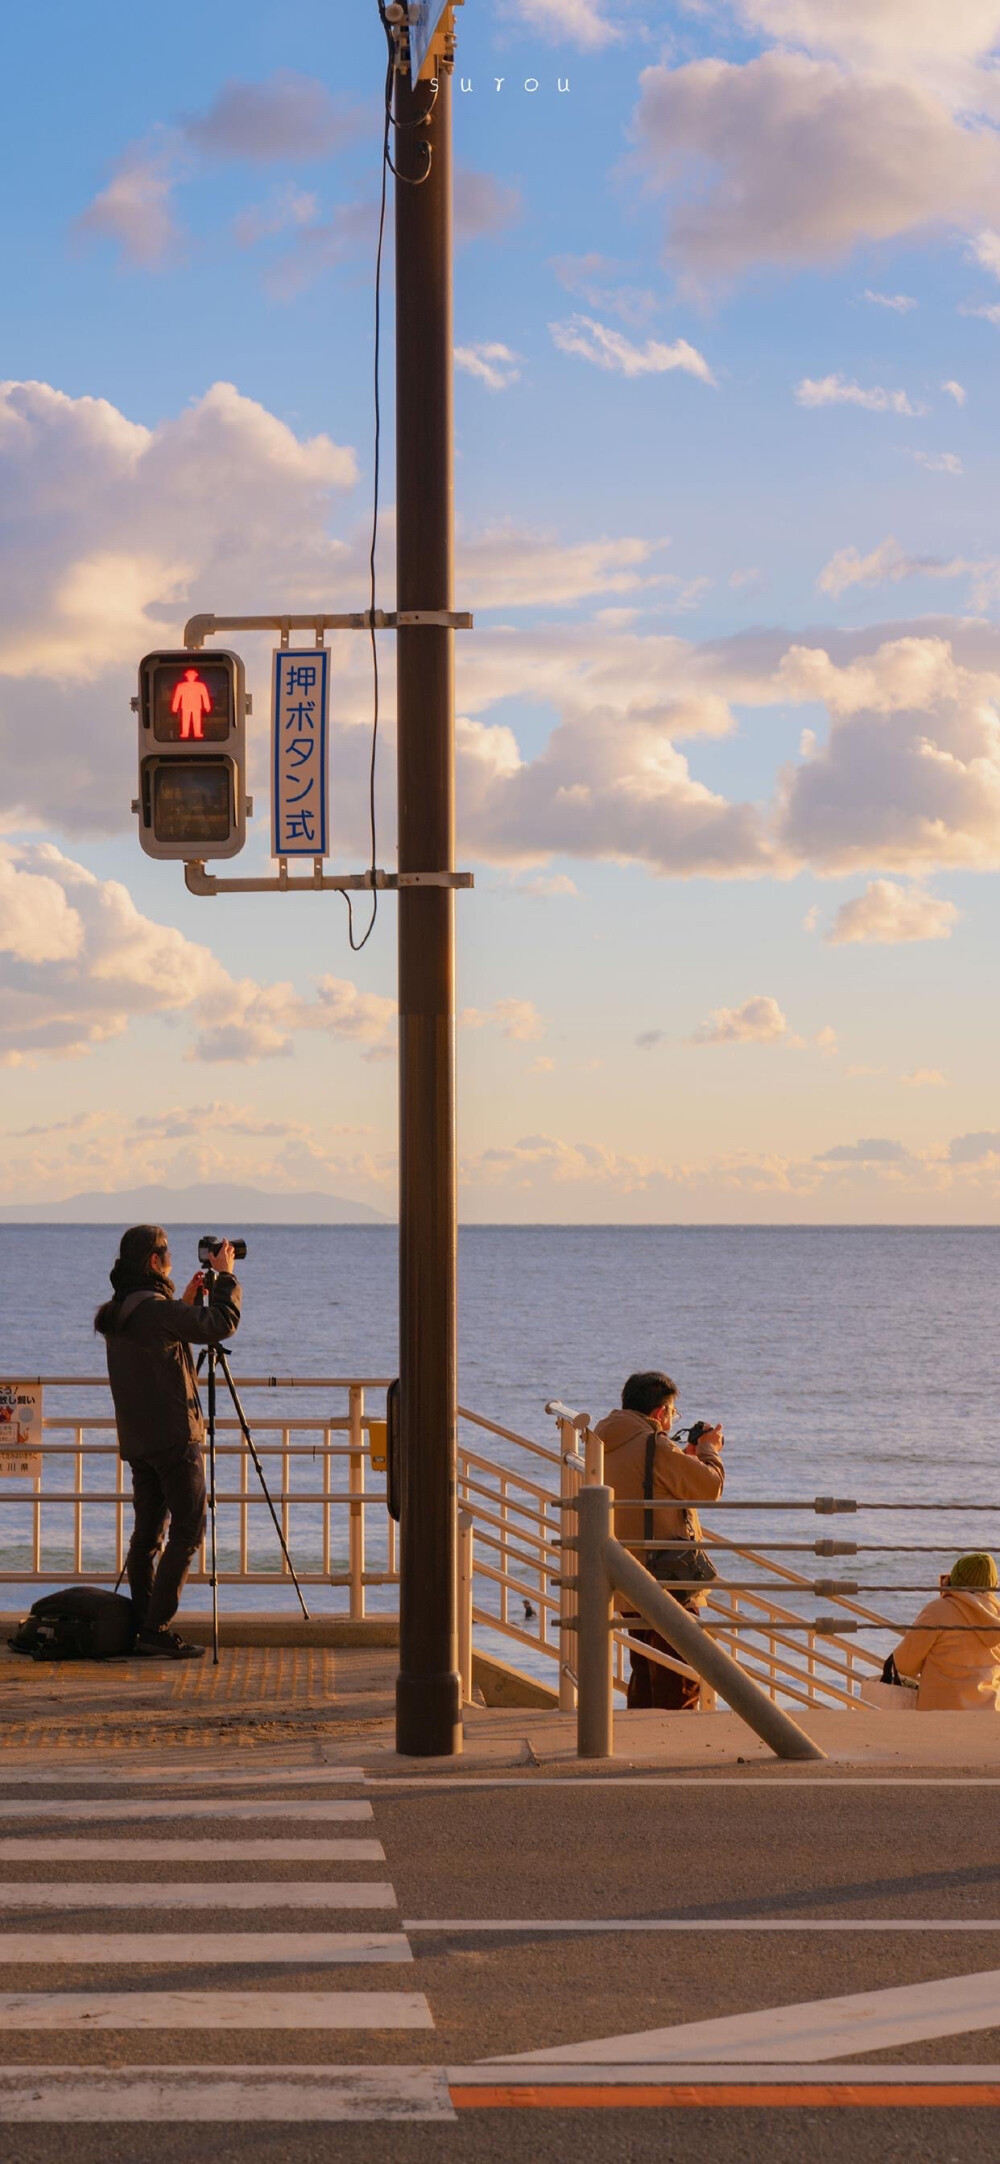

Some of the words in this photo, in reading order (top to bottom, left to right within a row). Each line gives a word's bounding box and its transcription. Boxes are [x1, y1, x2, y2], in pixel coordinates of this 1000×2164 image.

[285, 665, 316, 841] 押ボタン式
